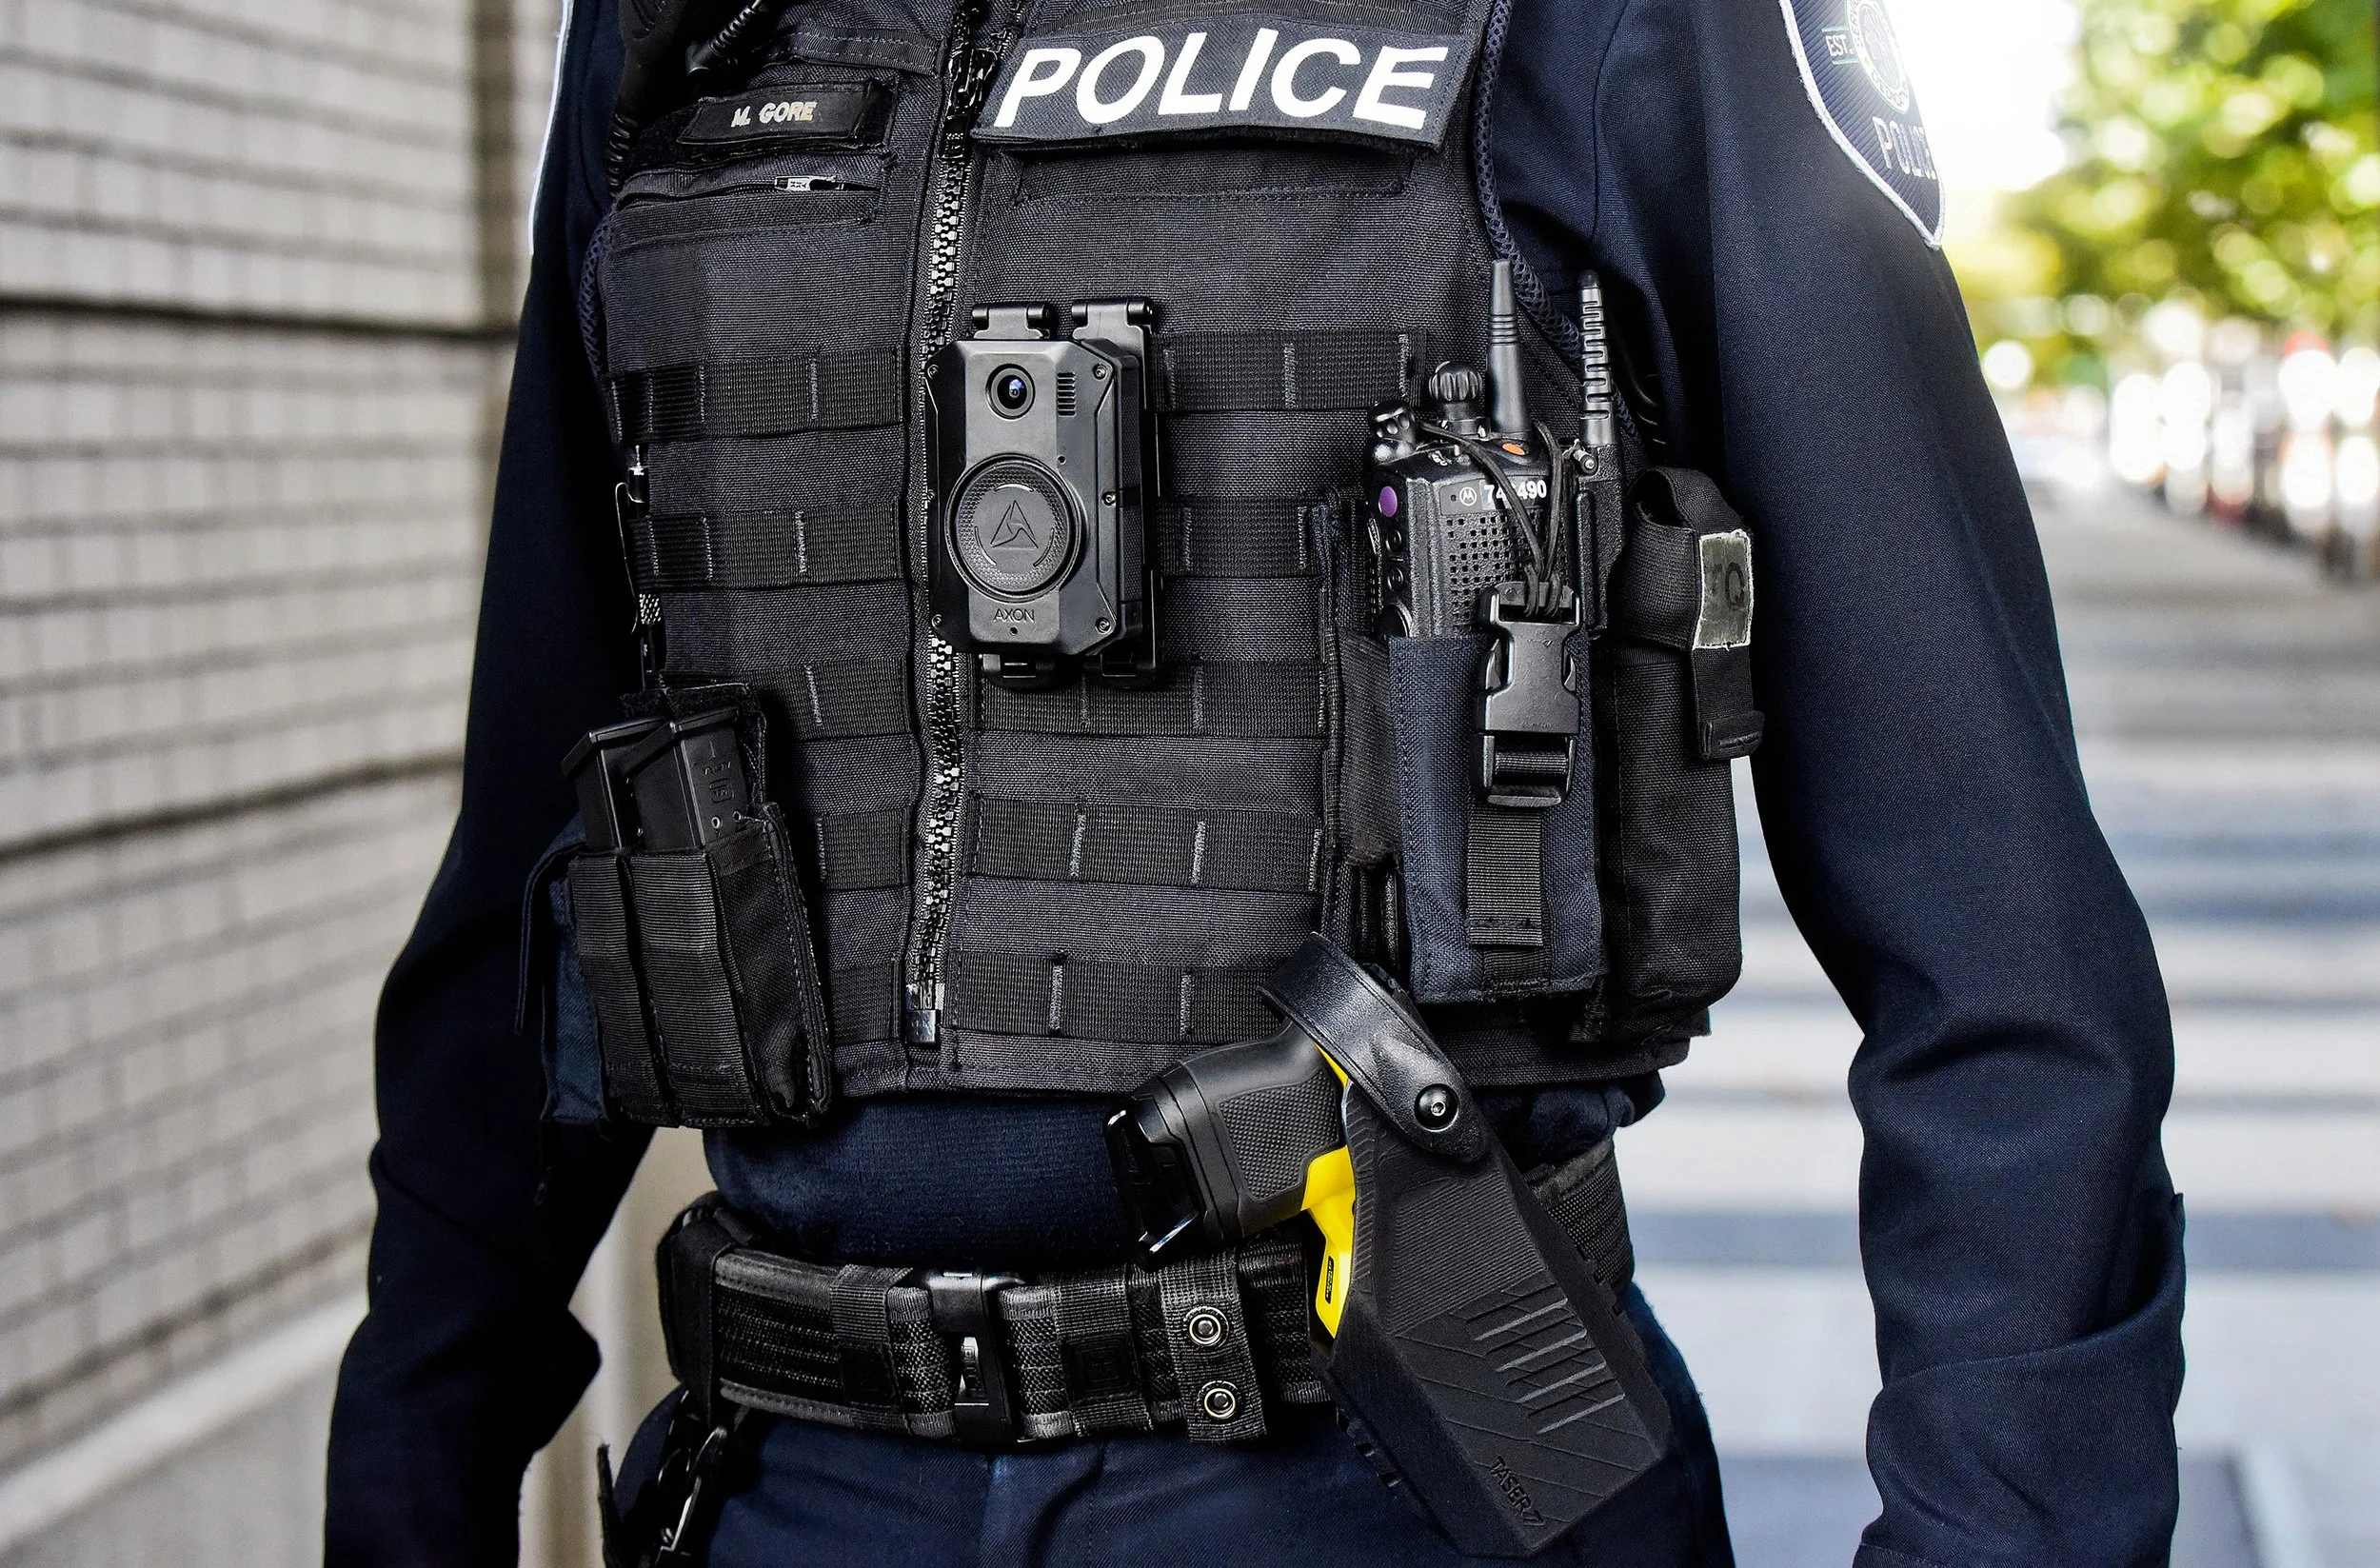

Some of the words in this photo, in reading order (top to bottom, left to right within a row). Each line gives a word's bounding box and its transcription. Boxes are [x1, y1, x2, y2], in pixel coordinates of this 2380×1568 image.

[1825, 34, 1854, 56] EST.
[993, 28, 1449, 129] POLICE
[730, 106, 751, 128] M.
[758, 101, 818, 124] GORE
[1872, 115, 1937, 180] POLIC
[1483, 479, 1548, 503] 74490
[993, 608, 1035, 622] AXON
